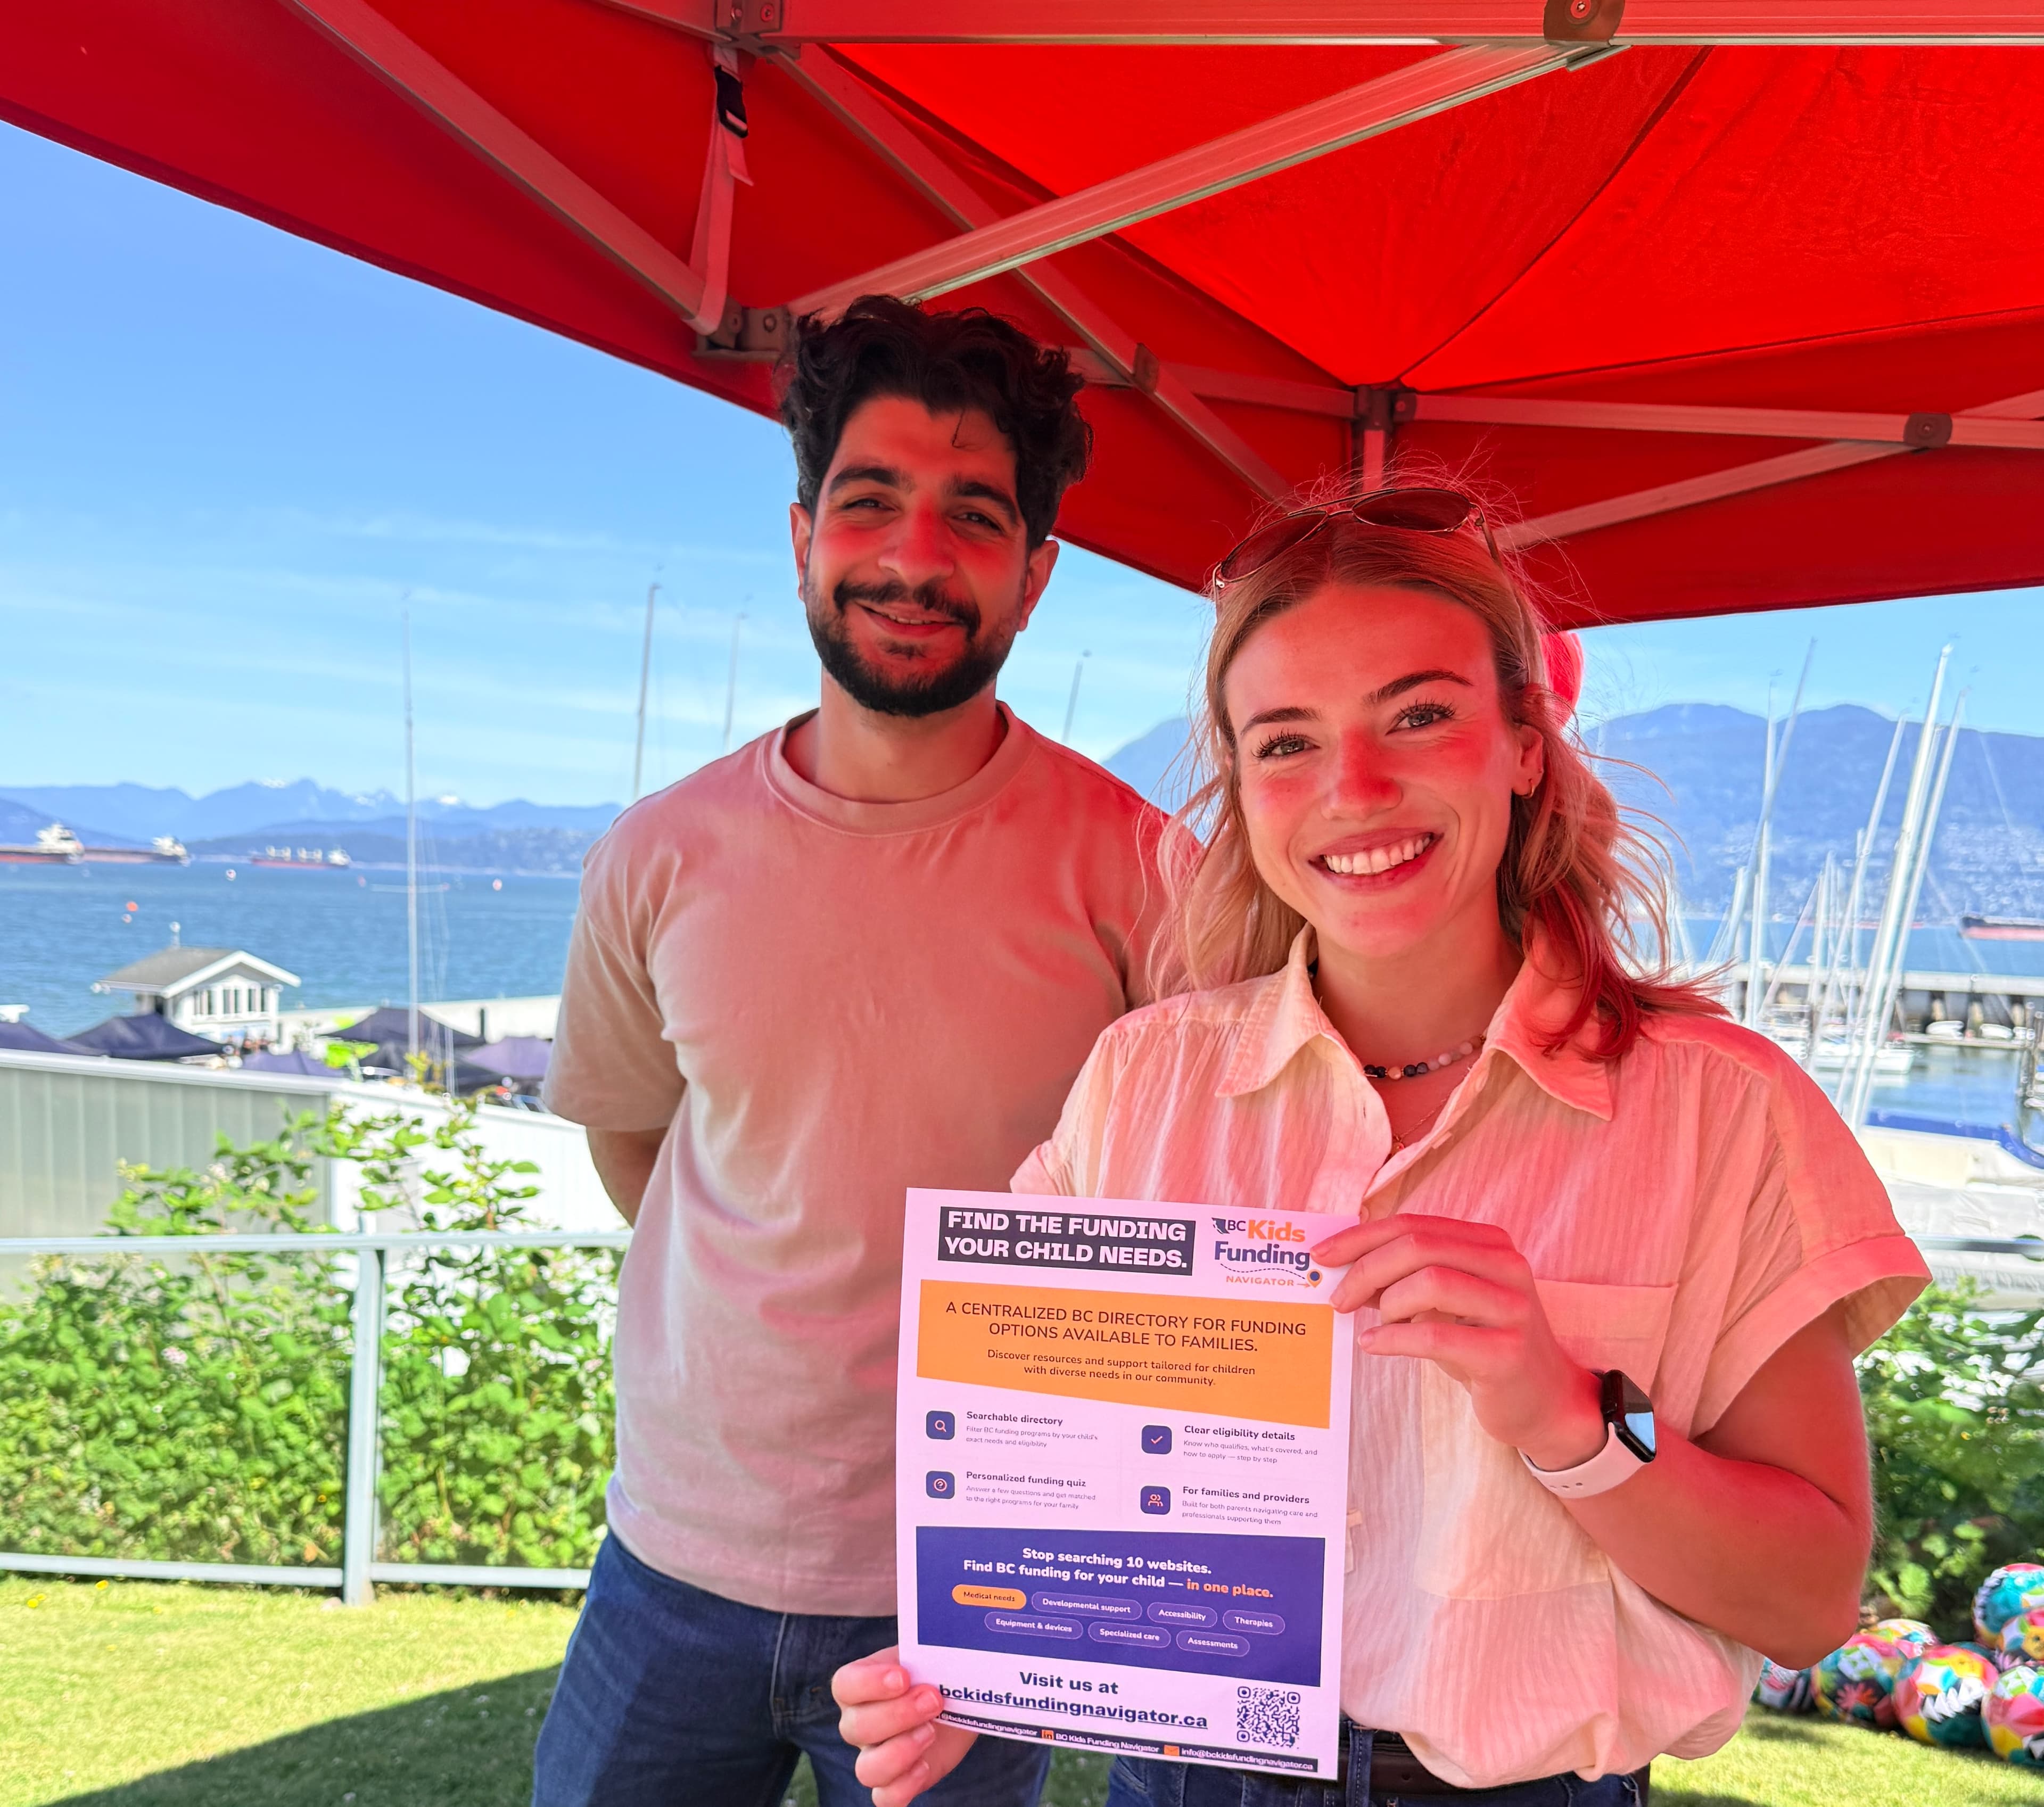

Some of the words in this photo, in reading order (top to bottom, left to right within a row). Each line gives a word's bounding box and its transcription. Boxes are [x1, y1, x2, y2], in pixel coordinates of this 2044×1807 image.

[948, 1211, 1009, 1231] FIND
[1016, 1215, 1062, 1234] THE
[1069, 1218, 1186, 1241] FUNDING
[1228, 1220, 1246, 1231] BC
[1248, 1219, 1306, 1242] Kids
[945, 1236, 1009, 1257] YOUR
[1015, 1241, 1093, 1261] CHILD
[1099, 1246, 1187, 1268] NEEDS.
[1215, 1241, 1310, 1271] Funding
[1226, 1276, 1293, 1286] NAVIGATOR
[946, 1301, 957, 1314] A
[962, 1302, 1067, 1321] CENTRALIZED
[1073, 1309, 1093, 1322] BC
[1098, 1311, 1188, 1329] DIRECTORY
[1194, 1318, 1225, 1331] FOR
[1231, 1320, 1306, 1335] FUNDING
[990, 1323, 1058, 1339] OPTIONS
[1063, 1328, 1150, 1345] AVAILABLE
[1155, 1334, 1176, 1346] TO
[1182, 1335, 1258, 1351] FAMILIES.
[988, 1350, 1030, 1360] Discover
[1033, 1354, 1082, 1364] resources
[1107, 1360, 1148, 1369] support
[1151, 1361, 1191, 1371] tailored
[1195, 1363, 1209, 1372] for
[1213, 1364, 1255, 1375] children
[1024, 1366, 1046, 1375] with
[1050, 1367, 1086, 1377] diverse
[1090, 1370, 1119, 1379] needs
[1123, 1371, 1132, 1380] in
[1156, 1375, 1216, 1387] community.
[967, 1412, 1018, 1422] Searchable
[1021, 1415, 1063, 1426] directory
[1184, 1425, 1210, 1434] Clear
[1213, 1428, 1259, 1439] eligibility
[1262, 1431, 1295, 1440] details
[966, 1471, 1025, 1482] Personalized
[1028, 1475, 1064, 1487] funding
[1067, 1479, 1086, 1487] quiz
[1201, 1488, 1240, 1498] families
[1263, 1494, 1309, 1504] providers
[1182, 1511, 1225, 1520] professionals
[1227, 1516, 1263, 1524] supporting
[1254, 1507, 1288, 1516] navigating
[1023, 1547, 1054, 1562] Stop
[1058, 1553, 1123, 1569] searching
[1126, 1557, 1143, 1568] 10
[1147, 1560, 1211, 1574] websites.
[963, 1560, 992, 1572] Find
[996, 1562, 1016, 1574] BC
[1018, 1564, 1070, 1581] funding
[1074, 1570, 1094, 1581] for
[1097, 1573, 1128, 1585] your
[1132, 1574, 1165, 1587] child
[1186, 1578, 1199, 1590] in
[1204, 1583, 1229, 1593] one
[1232, 1584, 1273, 1598] place.
[1043, 1598, 1099, 1610] Developmental
[1101, 1604, 1131, 1613] support
[1158, 1610, 1206, 1621] Accessibility
[1234, 1616, 1273, 1628] Therapies
[996, 1618, 1035, 1629] Equipment
[1045, 1624, 1072, 1632] devices
[1100, 1629, 1142, 1639] Specialized
[1188, 1637, 1238, 1649] Assessments
[1020, 1672, 1063, 1688] Visit
[1069, 1680, 1092, 1692] us
[1099, 1682, 1118, 1694] at
[939, 1684, 1208, 1728] bckidsfundingnavigator.ca
[1087, 1737, 1120, 1748] Funding
[1121, 1742, 1159, 1752] Navigator
[1181, 1748, 1313, 1770] info@bckidsfundingnavigator.ca
